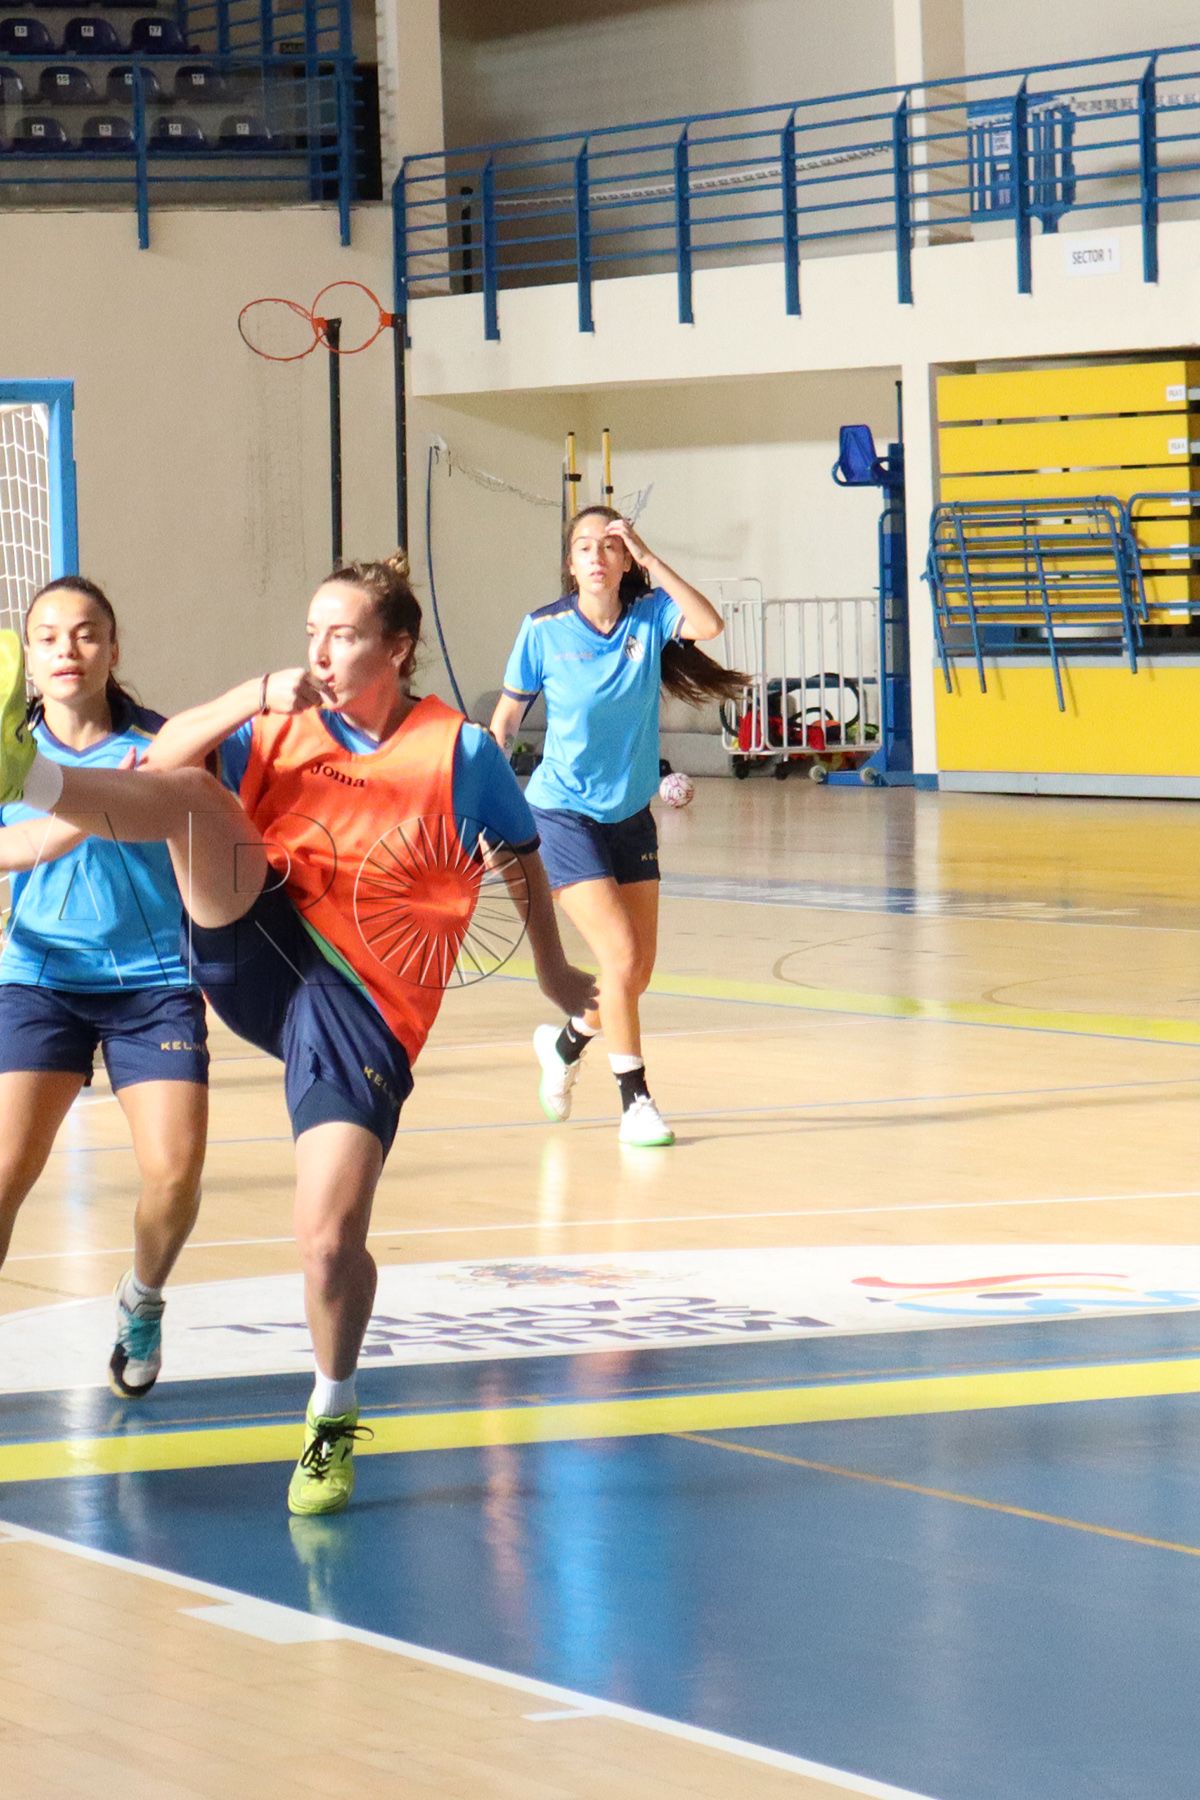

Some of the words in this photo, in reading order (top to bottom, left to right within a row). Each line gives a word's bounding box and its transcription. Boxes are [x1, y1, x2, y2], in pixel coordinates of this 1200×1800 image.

[1072, 248, 1104, 264] SECTOR
[310, 761, 365, 788] Joma
[369, 1304, 778, 1342] SPORT
